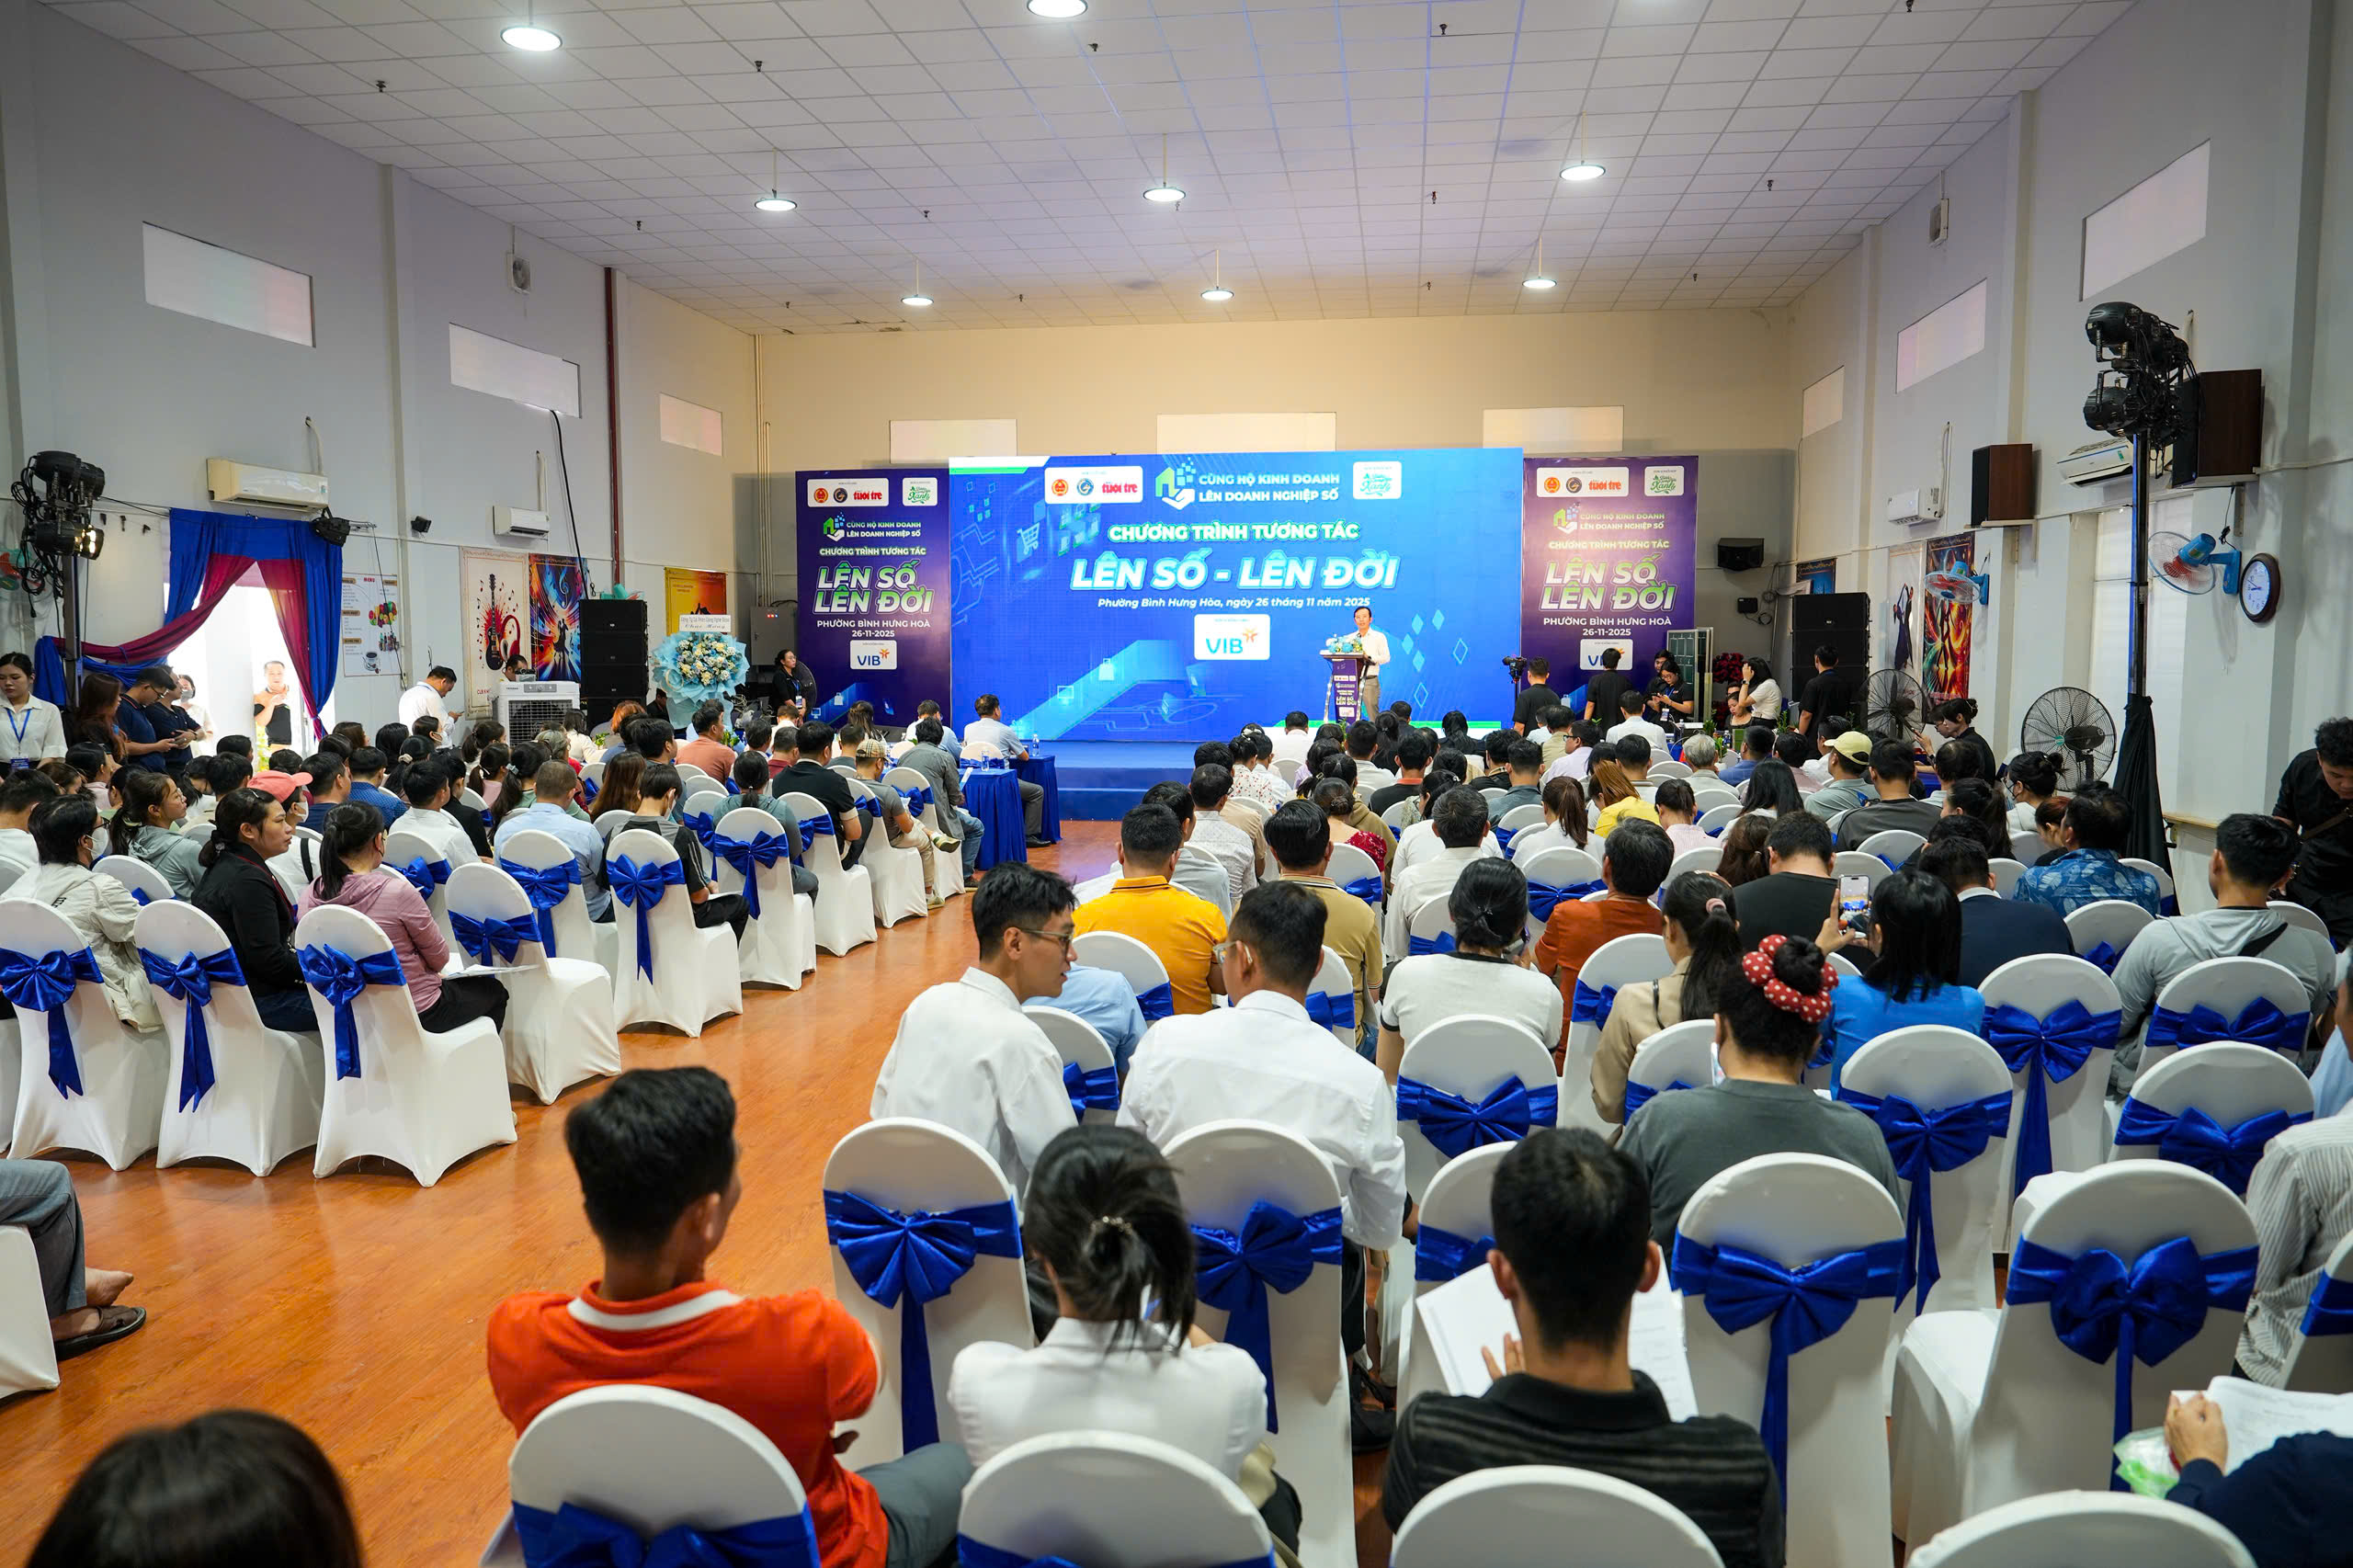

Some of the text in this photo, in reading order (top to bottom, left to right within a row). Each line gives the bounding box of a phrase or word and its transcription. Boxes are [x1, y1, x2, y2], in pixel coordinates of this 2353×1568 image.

[1199, 472, 1339, 486] CÙNG HỘ KINH DOANH
[1199, 487, 1339, 503] LÊN DOANH NGHIỆP SỐ
[1108, 519, 1360, 542] CHƯƠNG TRÌNH TƯƠNG TÁC
[1625, 522, 1653, 530] NGHIỆP
[1654, 521, 1664, 529] SỐ
[819, 546, 926, 555] CHƯƠNG TRÌNH TƯƠNG TÁC
[1549, 540, 1669, 549] CHƯƠNG TRÌNH TƯƠNG TÁC
[817, 559, 920, 589] LÊN SỐ
[1071, 551, 1147, 590] LÊN
[1150, 548, 1212, 590] SỐ
[1236, 549, 1317, 589] LÊN
[1321, 549, 1401, 589] ĐỜI
[1544, 553, 1662, 585] LÊN SỐ
[813, 584, 934, 614] LÊN ĐỜI
[1098, 598, 1139, 608] Phường
[1142, 598, 1165, 607] Bình
[1168, 598, 1197, 608] Hưng
[1199, 598, 1223, 608] Hòa,
[1226, 598, 1255, 608] ngày
[1271, 598, 1303, 608] tháng
[1540, 580, 1677, 611] LÊN ĐỜI
[817, 619, 856, 627] PHƯỜNG
[858, 619, 880, 627] BÌNH
[911, 619, 930, 627] HOÀ
[1544, 616, 1671, 625] PHƯỜNG BÌNH HƯNG HOÀ
[1206, 638, 1244, 654] VIB
[857, 655, 881, 665] VIB
